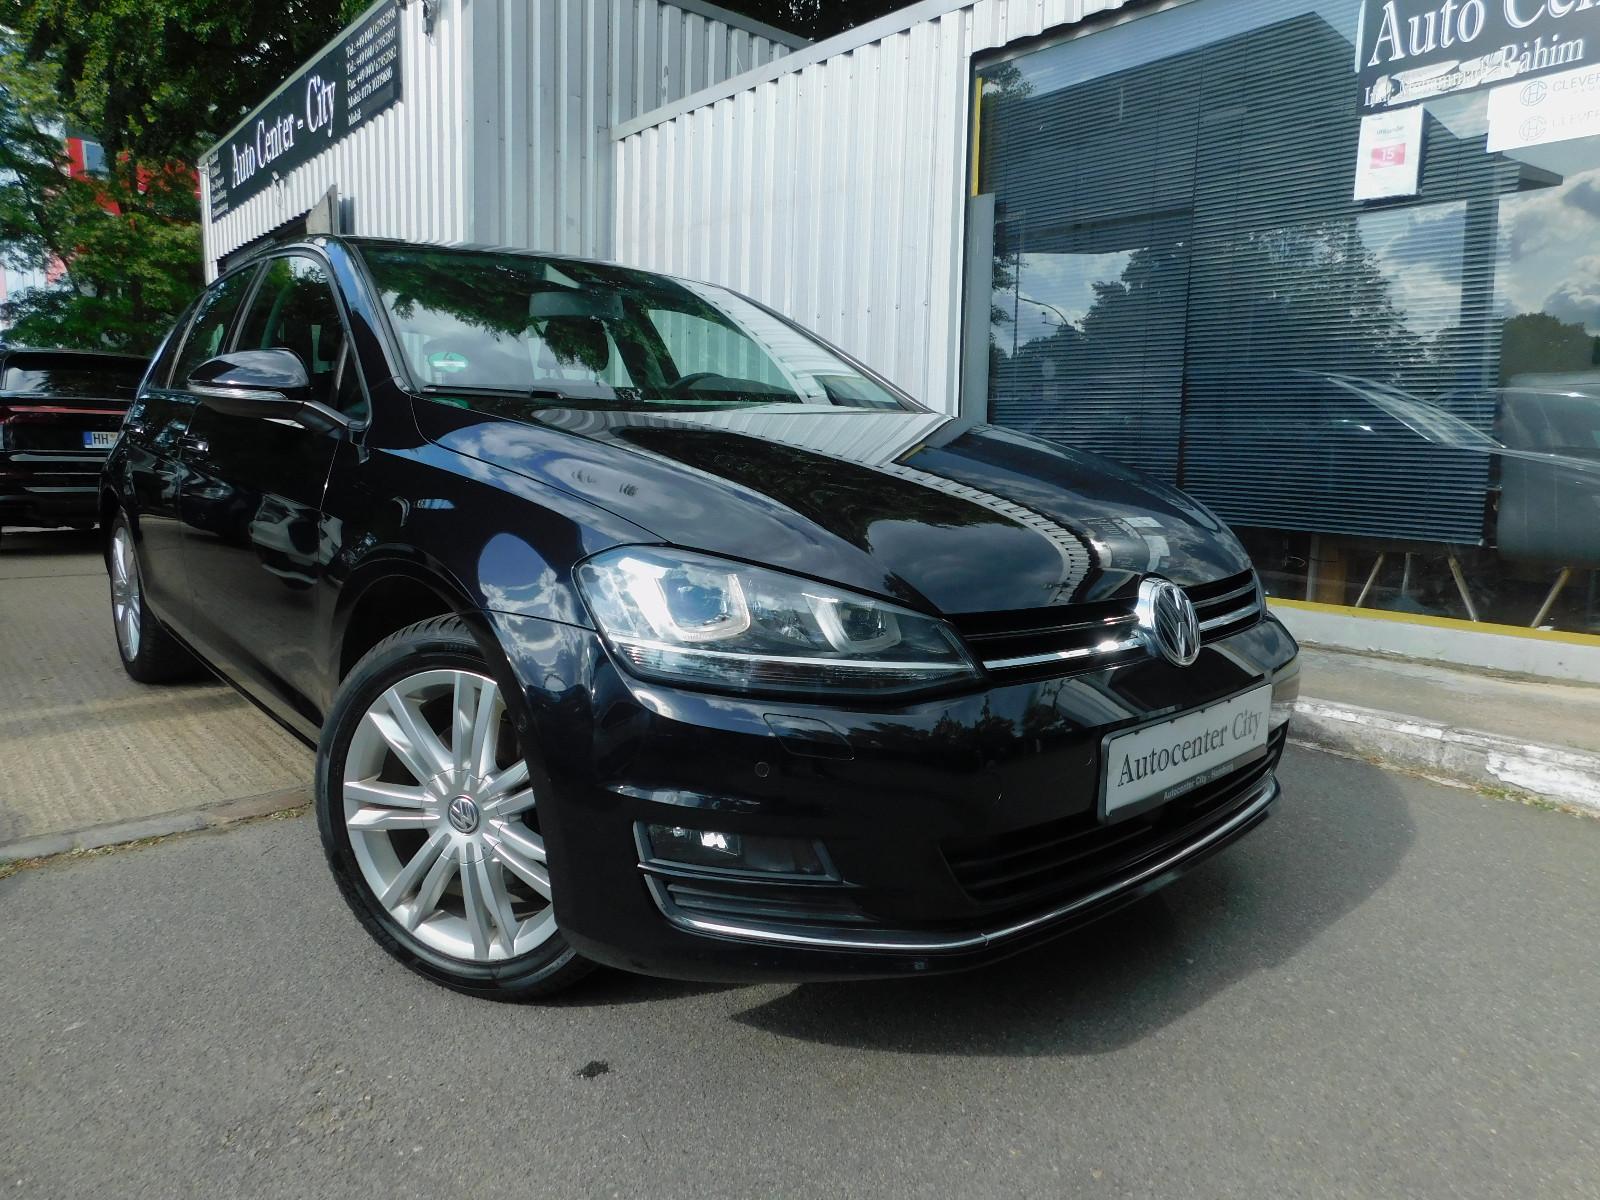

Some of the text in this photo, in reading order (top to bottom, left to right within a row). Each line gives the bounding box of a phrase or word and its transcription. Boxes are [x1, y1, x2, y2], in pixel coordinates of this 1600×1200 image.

[1367, 0, 1487, 67] Auto
[231, 143, 255, 189] Auto
[256, 114, 295, 169] Center
[305, 75, 336, 138] City
[1117, 709, 1263, 787] Autocenter City
